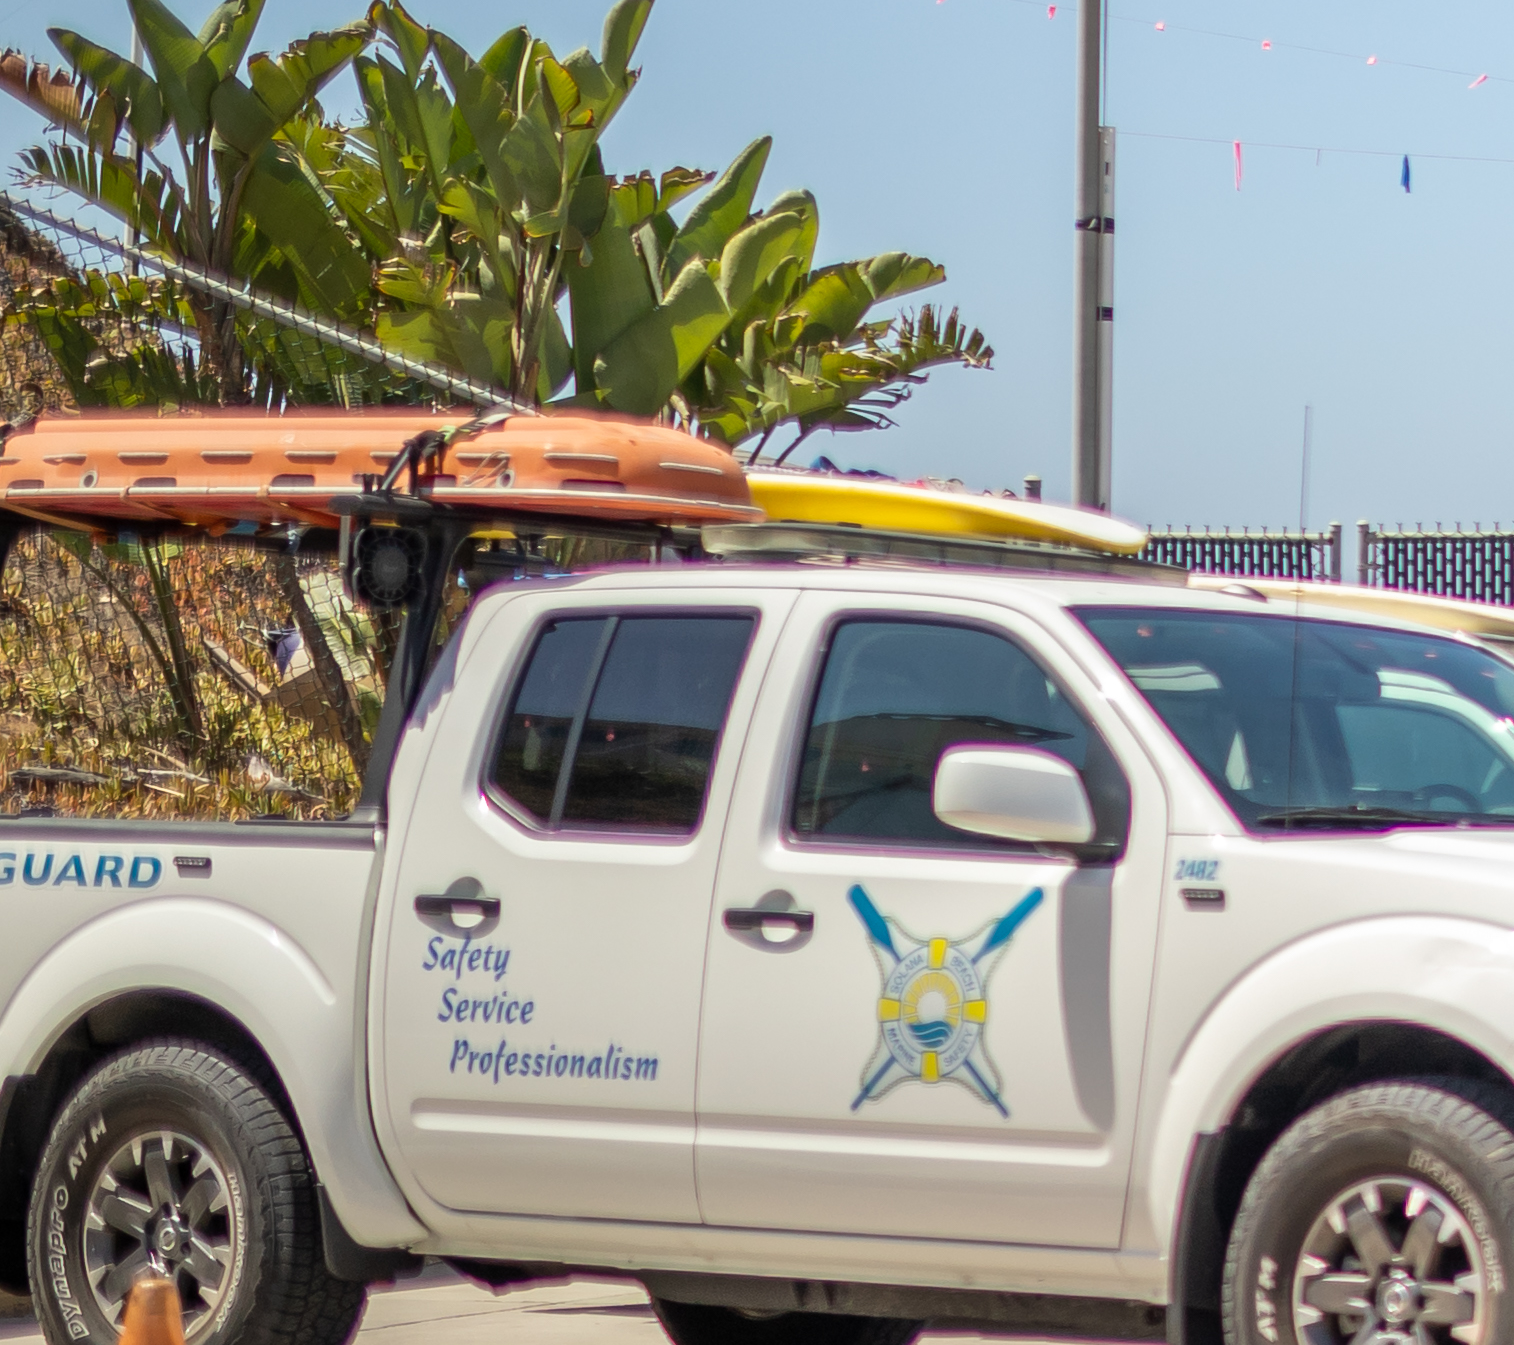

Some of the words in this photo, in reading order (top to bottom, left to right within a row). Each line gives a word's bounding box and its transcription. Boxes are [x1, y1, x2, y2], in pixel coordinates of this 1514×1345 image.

[0, 852, 163, 889] GUARD
[422, 931, 511, 982] Safety
[890, 954, 924, 994] SOLANA
[951, 956, 977, 993] BEACH
[437, 987, 534, 1025] Service
[449, 1038, 659, 1085] Professionalism
